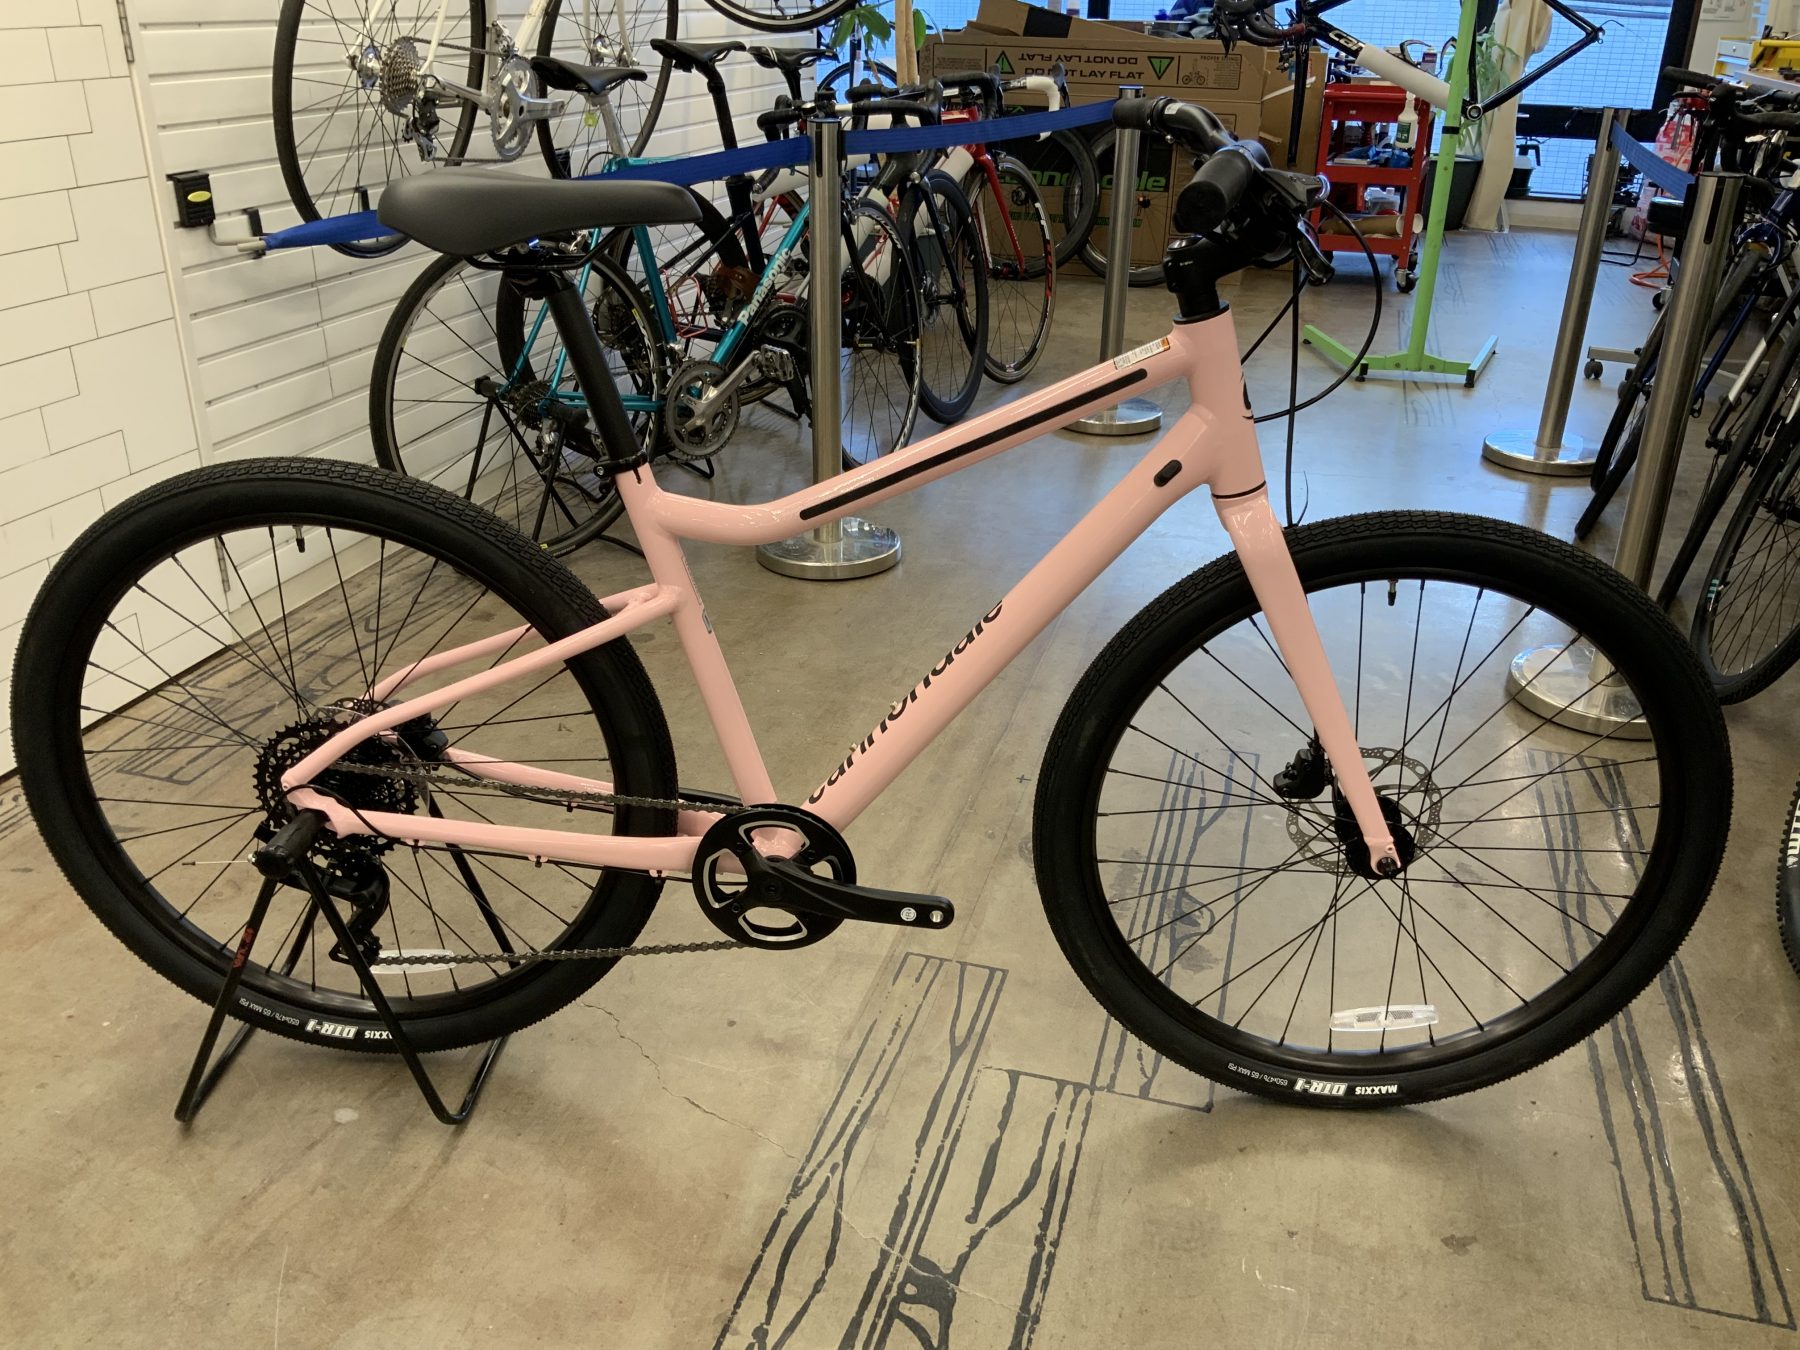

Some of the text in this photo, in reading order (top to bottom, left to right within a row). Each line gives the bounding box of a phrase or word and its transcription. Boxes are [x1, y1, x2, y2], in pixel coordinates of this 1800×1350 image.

[1018, 53, 1138, 65] DO NOT LAY FLAT
[1024, 67, 1045, 76] DO
[1079, 69, 1107, 79] LAY
[1109, 71, 1144, 79] FLAT
[737, 248, 791, 326] Panasonic
[305, 1018, 359, 1040] DTR-1
[1237, 1066, 1251, 1077] MAX
[1294, 1077, 1348, 1097] DTR-1
[1355, 1084, 1398, 1095] MAXXIS
